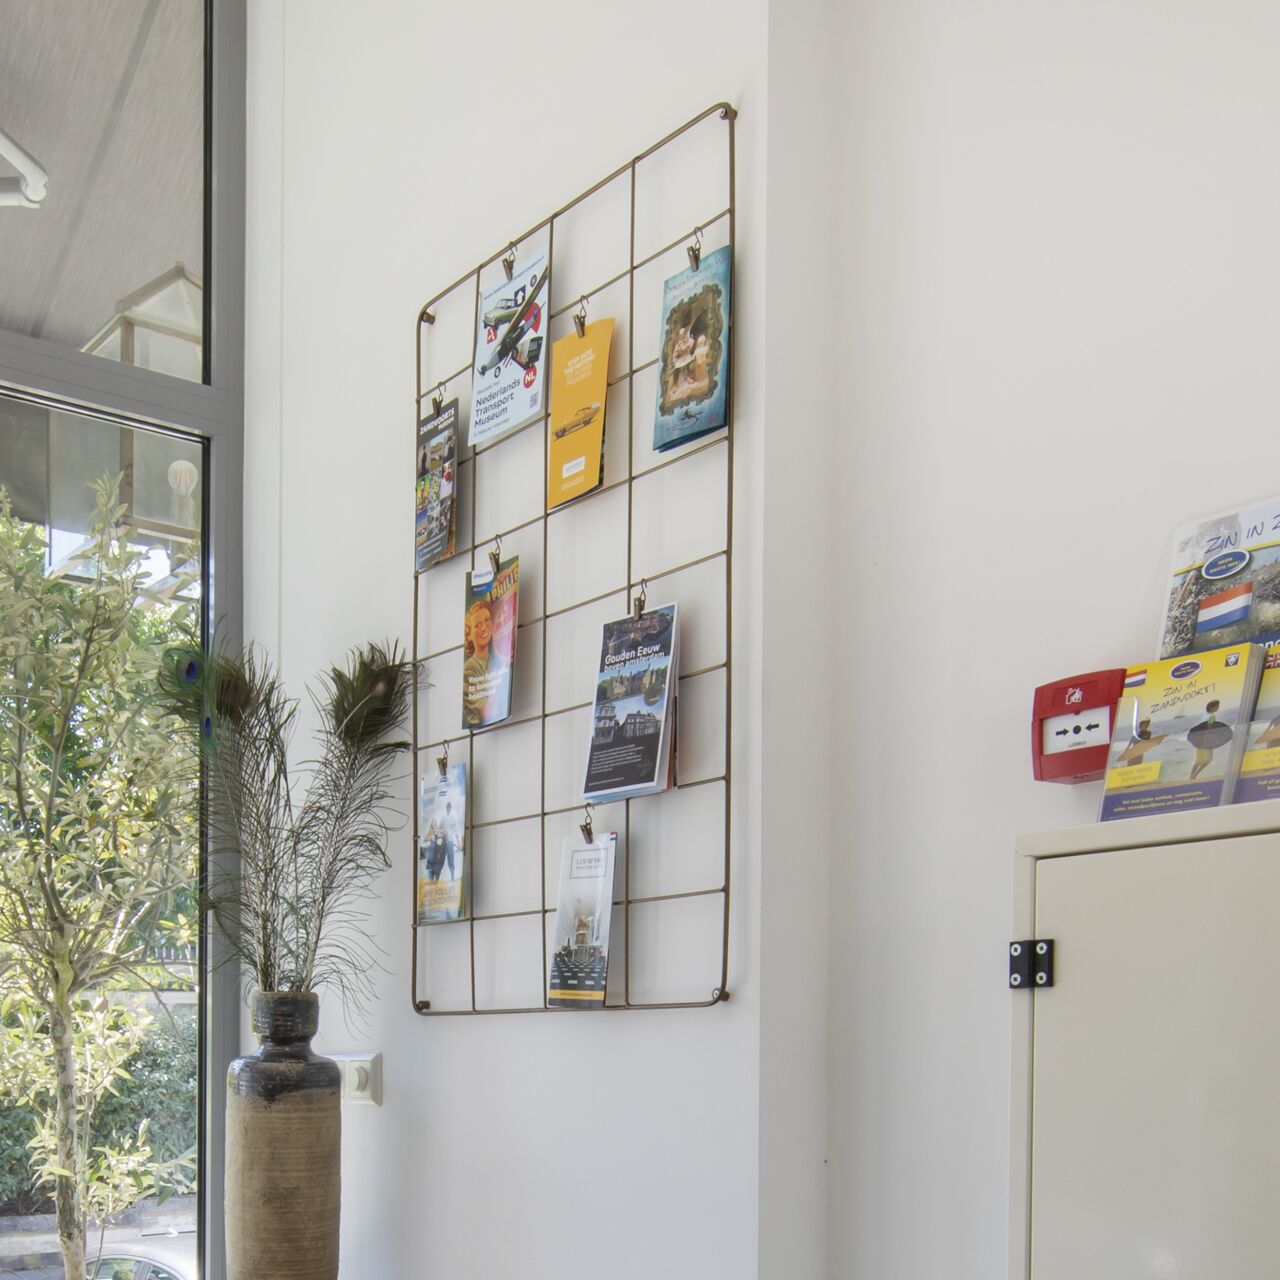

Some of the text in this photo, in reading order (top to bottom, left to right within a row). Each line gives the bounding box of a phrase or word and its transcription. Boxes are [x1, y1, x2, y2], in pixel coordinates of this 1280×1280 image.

[524, 370, 536, 385] NL
[476, 378, 521, 408] Nederlands
[476, 392, 514, 417] Transport
[474, 406, 508, 428] Museum
[1204, 532, 1238, 554] ZIN
[1246, 521, 1264, 540] IN
[604, 643, 661, 665] Gouden Eeuw
[625, 651, 665, 667] amsterdam
[1163, 679, 1197, 698] ZIN IN
